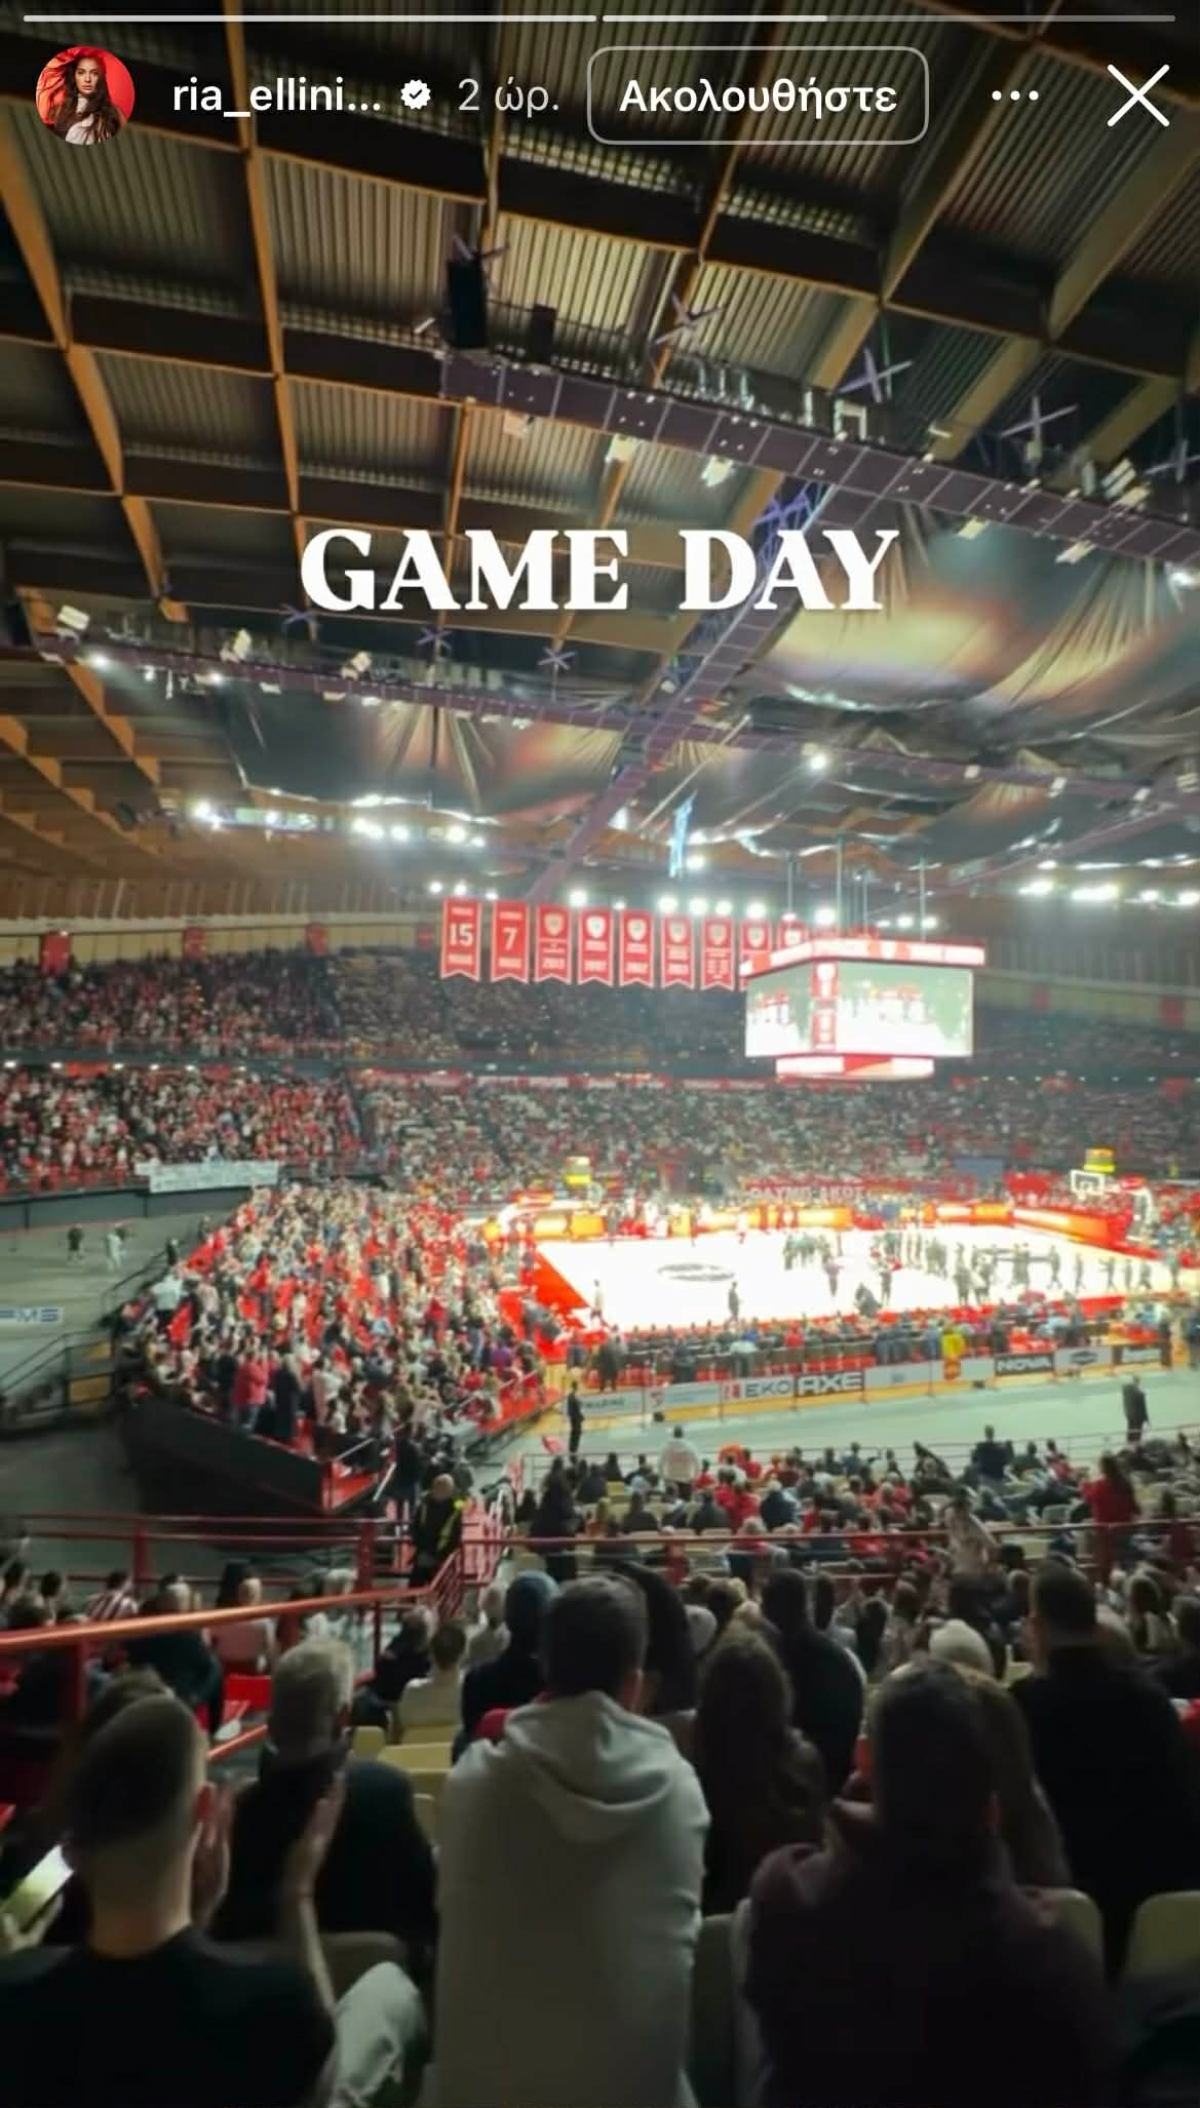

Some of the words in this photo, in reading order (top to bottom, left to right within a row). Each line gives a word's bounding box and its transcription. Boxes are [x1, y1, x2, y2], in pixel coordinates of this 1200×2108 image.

[450, 923, 474, 947] 15
[503, 927, 518, 951] 7
[745, 1380, 793, 1397] EKO
[798, 1371, 863, 1395] AXE
